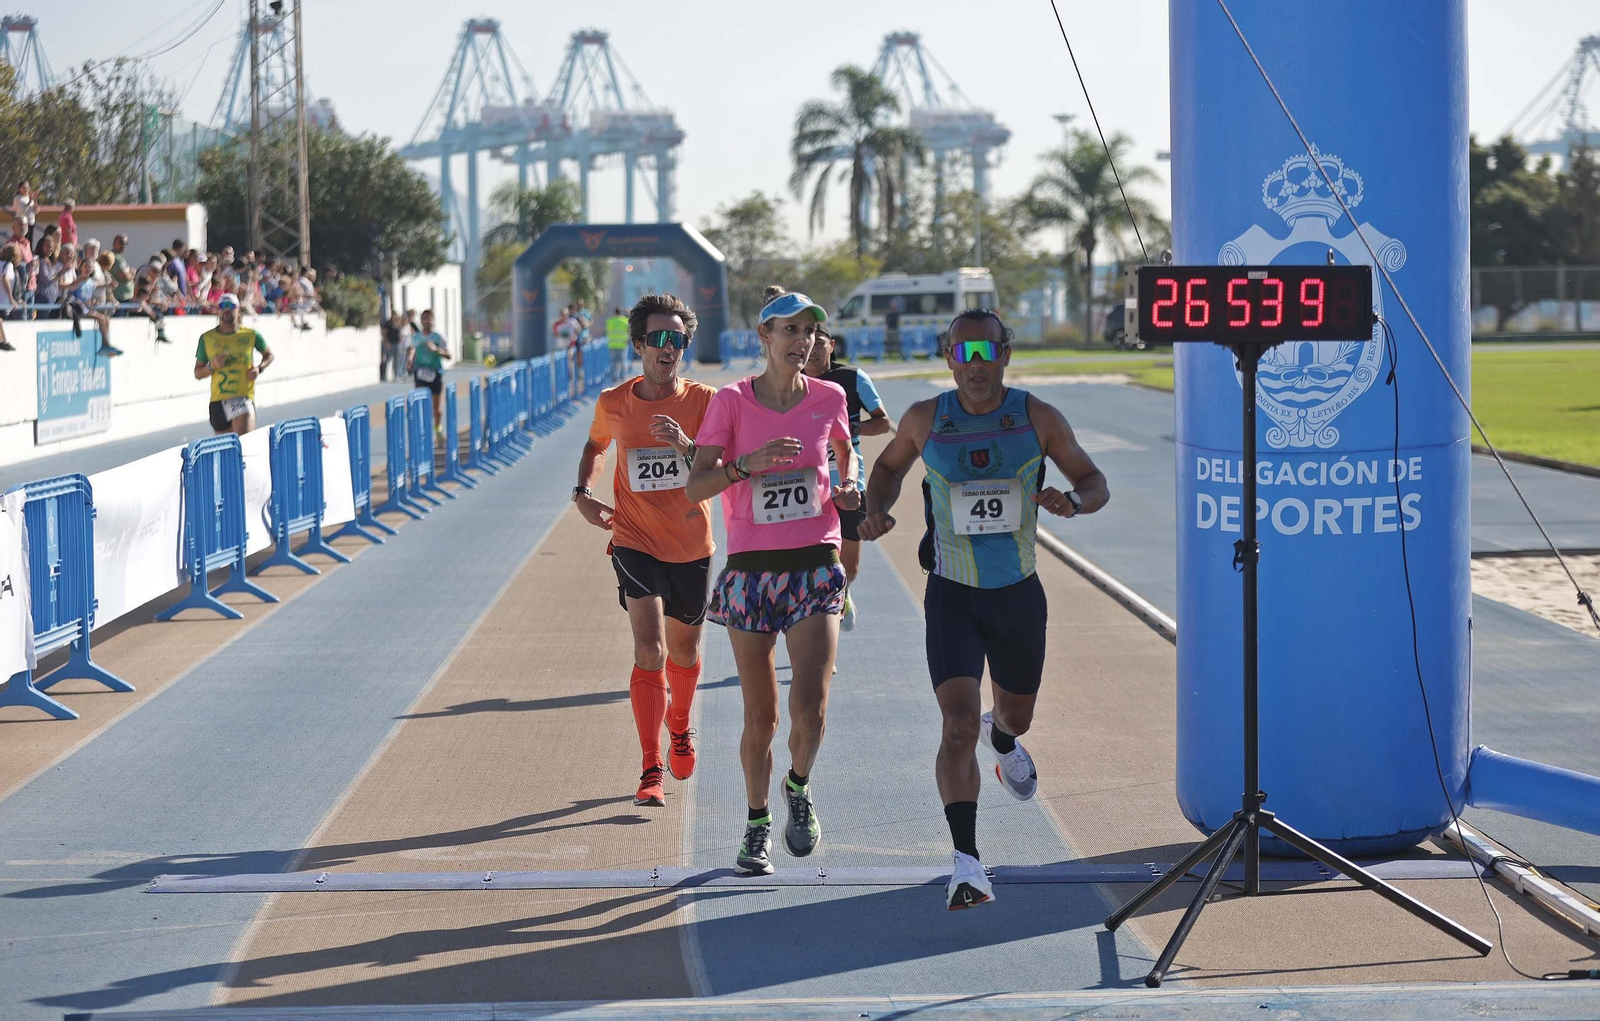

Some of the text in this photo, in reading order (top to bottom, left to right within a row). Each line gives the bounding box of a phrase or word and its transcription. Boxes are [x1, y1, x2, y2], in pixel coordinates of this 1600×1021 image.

[1152, 278, 1209, 327] 26
[52, 358, 107, 403] Enrique Talavera
[1347, 385, 1360, 401] BIS
[1280, 409, 1293, 418] EX
[637, 461, 680, 480] 204
[1387, 456, 1423, 484] DE
[761, 481, 778, 489] CIUDAD
[762, 485, 809, 510] 270
[970, 498, 1003, 519] 49
